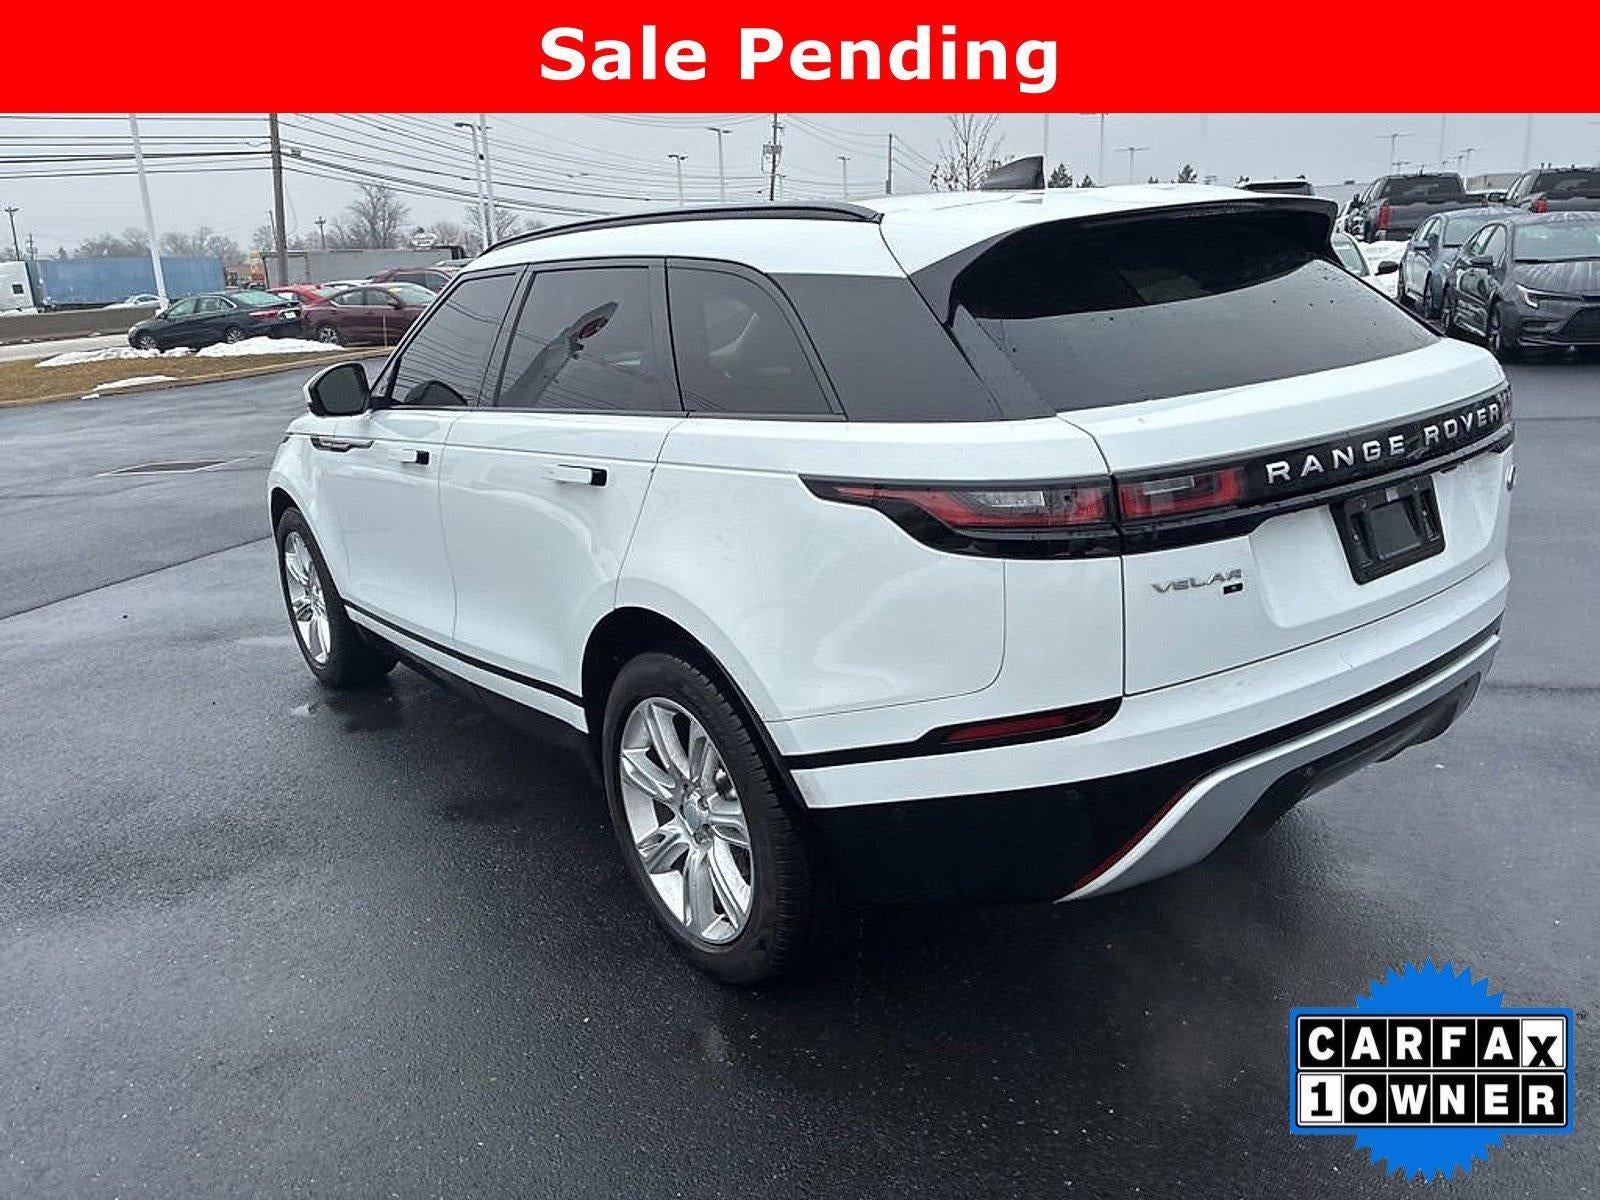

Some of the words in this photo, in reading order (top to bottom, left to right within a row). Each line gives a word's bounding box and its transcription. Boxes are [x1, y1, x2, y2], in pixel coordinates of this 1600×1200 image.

[1265, 434, 1406, 484] RANGE
[1423, 402, 1501, 447] ROVER
[1151, 568, 1242, 594] VELAR
